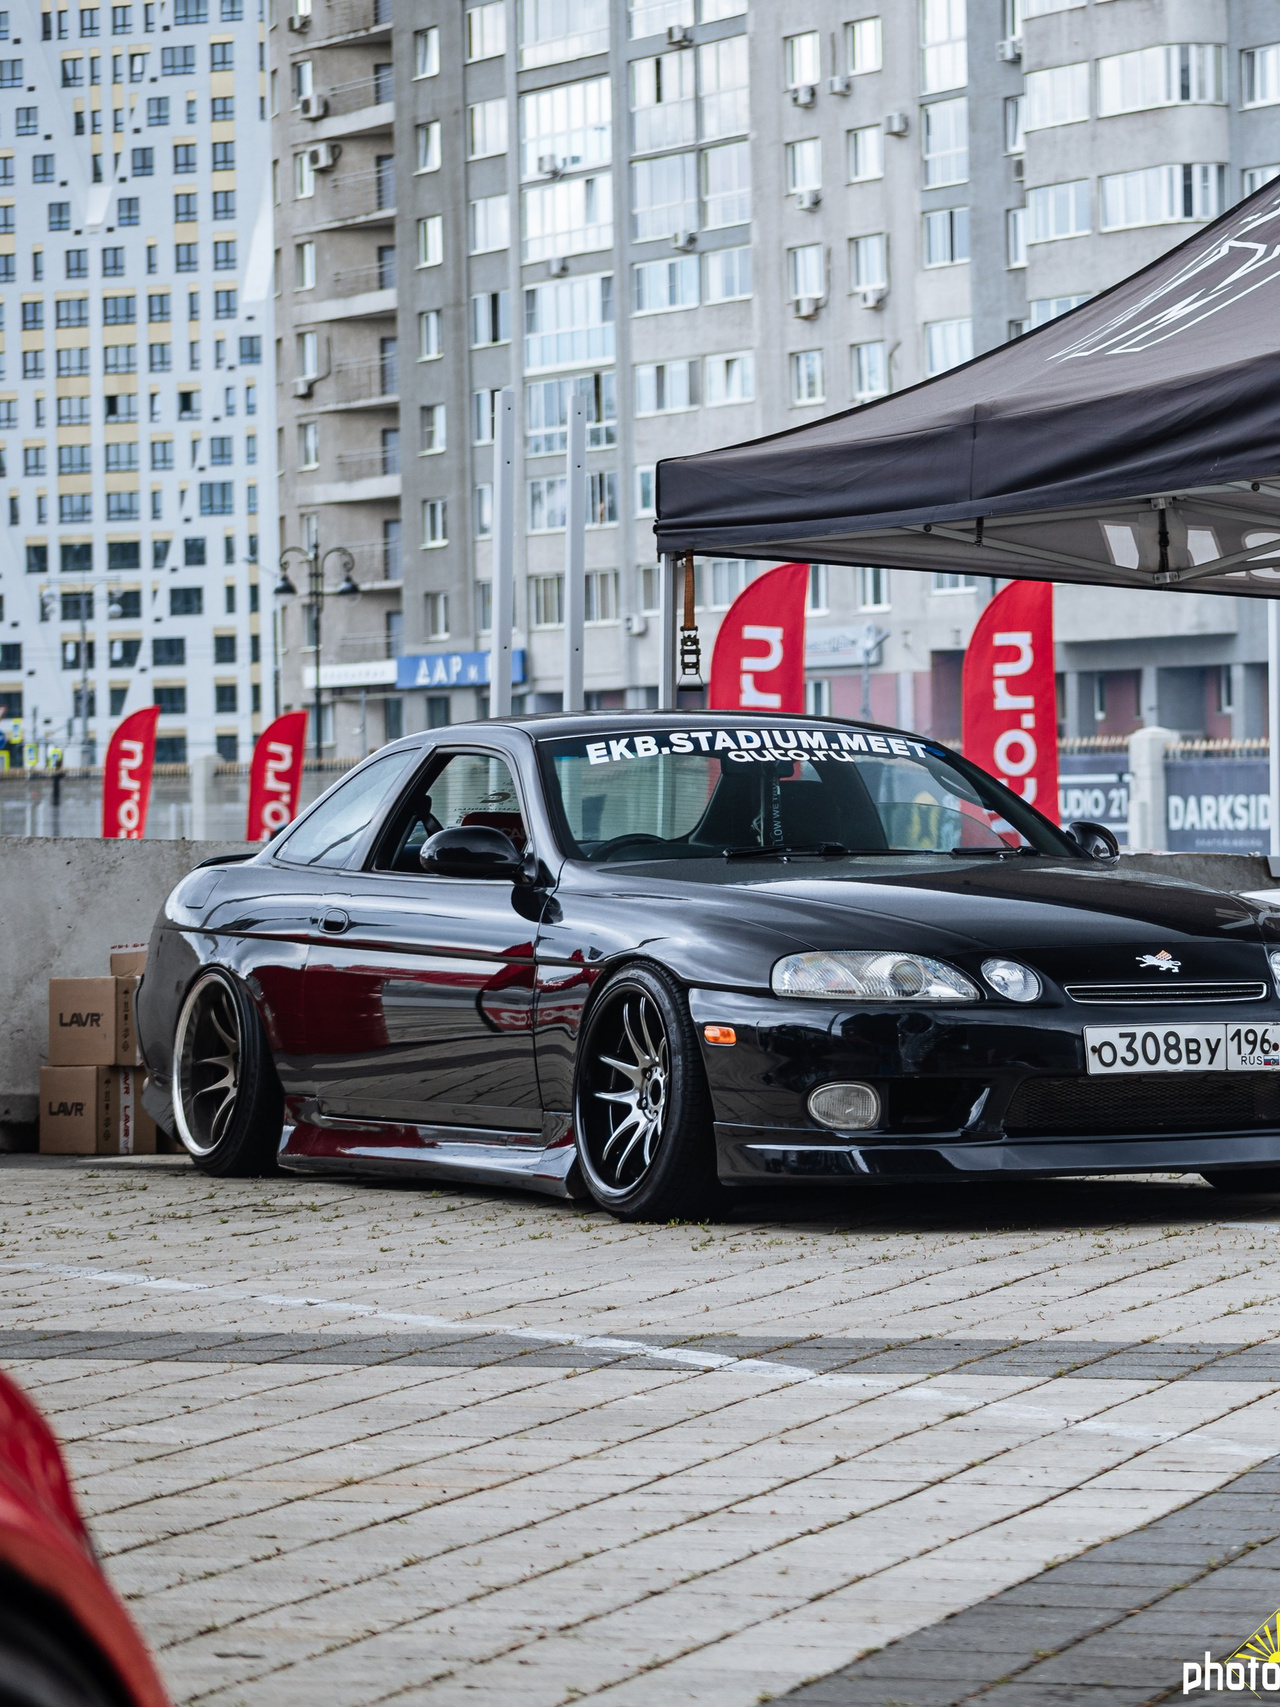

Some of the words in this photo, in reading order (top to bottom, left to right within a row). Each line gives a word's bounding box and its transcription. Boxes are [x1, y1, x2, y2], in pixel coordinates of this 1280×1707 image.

[739, 624, 784, 709] ru
[585, 730, 926, 765] EKB.STADIUM.MEET
[727, 747, 855, 762] auto.ru
[260, 742, 293, 841] o.ru
[1058, 788, 1106, 818] UDIO
[1168, 793, 1271, 831] DARKSID
[59, 1012, 101, 1027] LAVR
[1229, 1028, 1272, 1056] 196
[1240, 1055, 1263, 1066] RUS
[48, 1101, 84, 1117] LAVR
